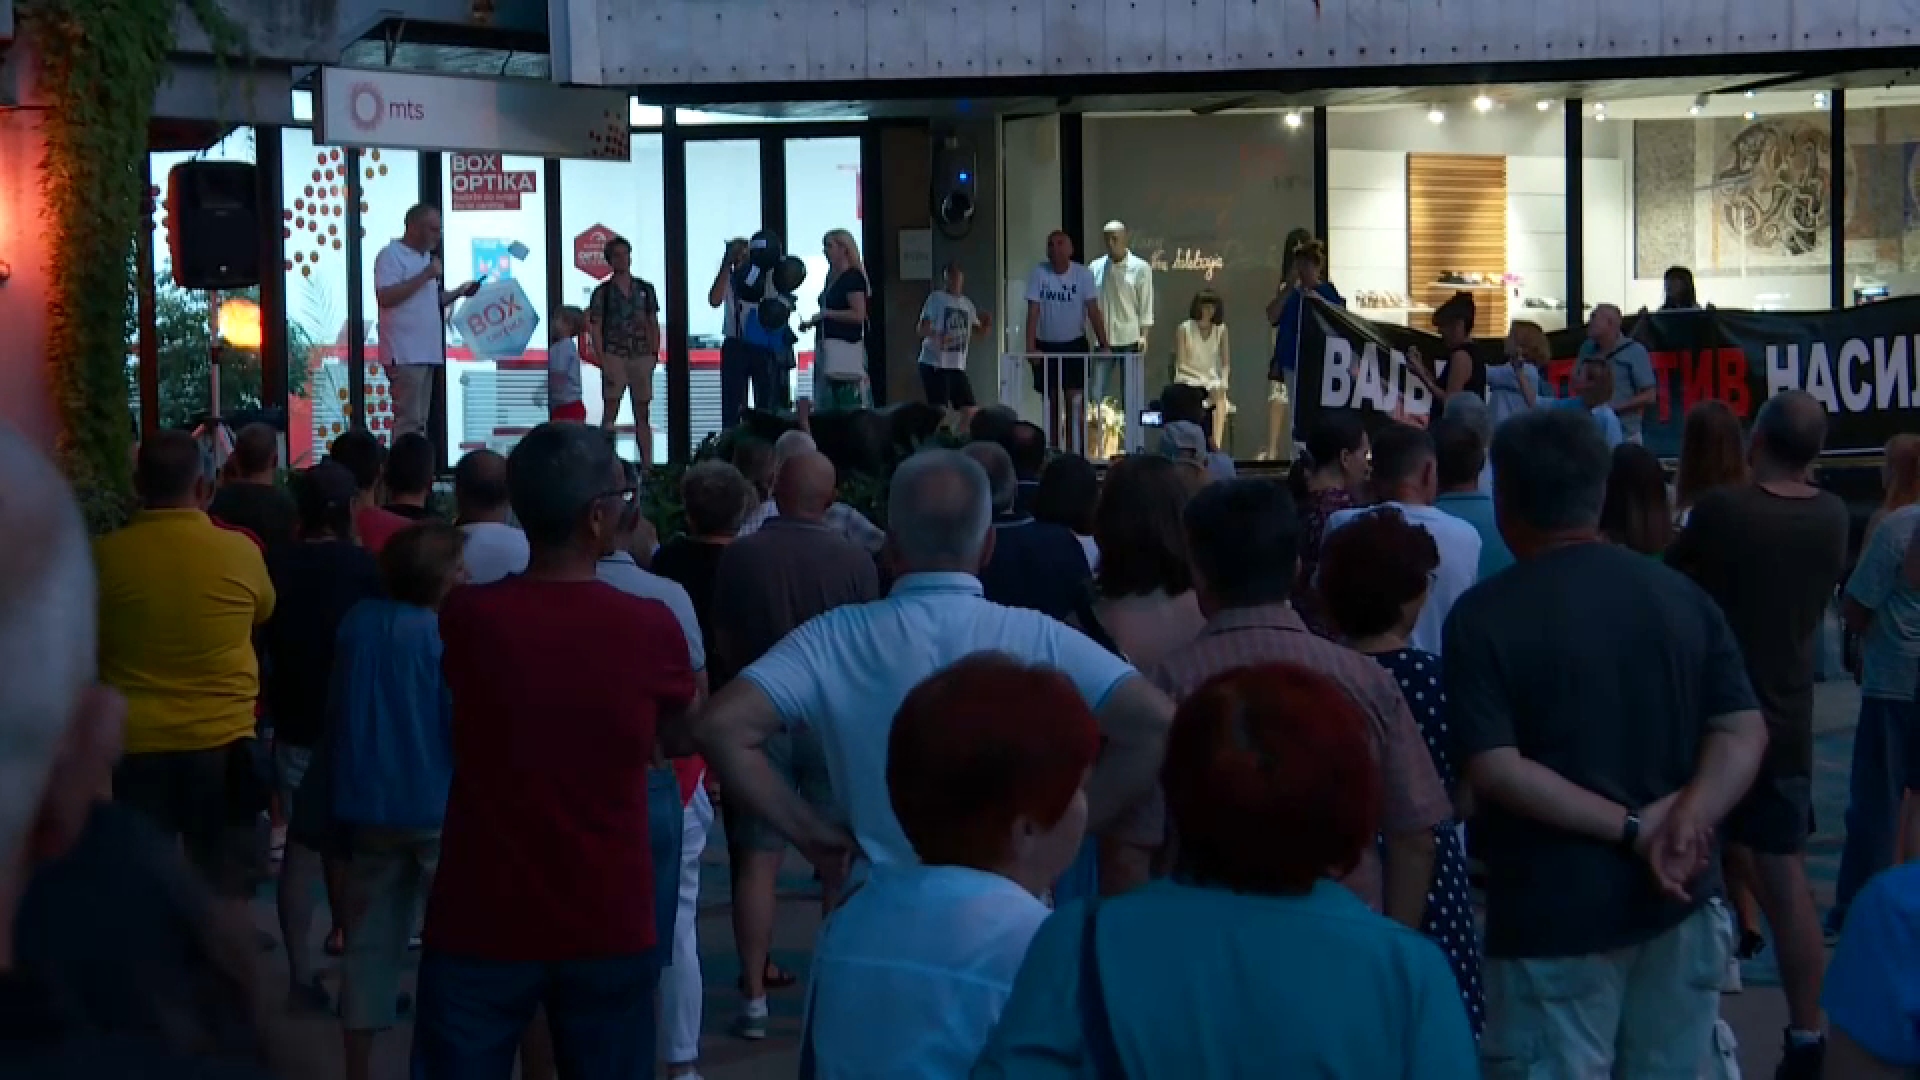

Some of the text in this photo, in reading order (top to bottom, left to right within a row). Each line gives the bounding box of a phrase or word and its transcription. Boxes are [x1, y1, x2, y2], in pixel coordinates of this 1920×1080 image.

[389, 99, 425, 120] mts
[453, 155, 497, 172] BOX
[453, 173, 533, 193] OPTIKA
[467, 293, 523, 338] BOX
[1765, 334, 1920, 412] НАСИ
